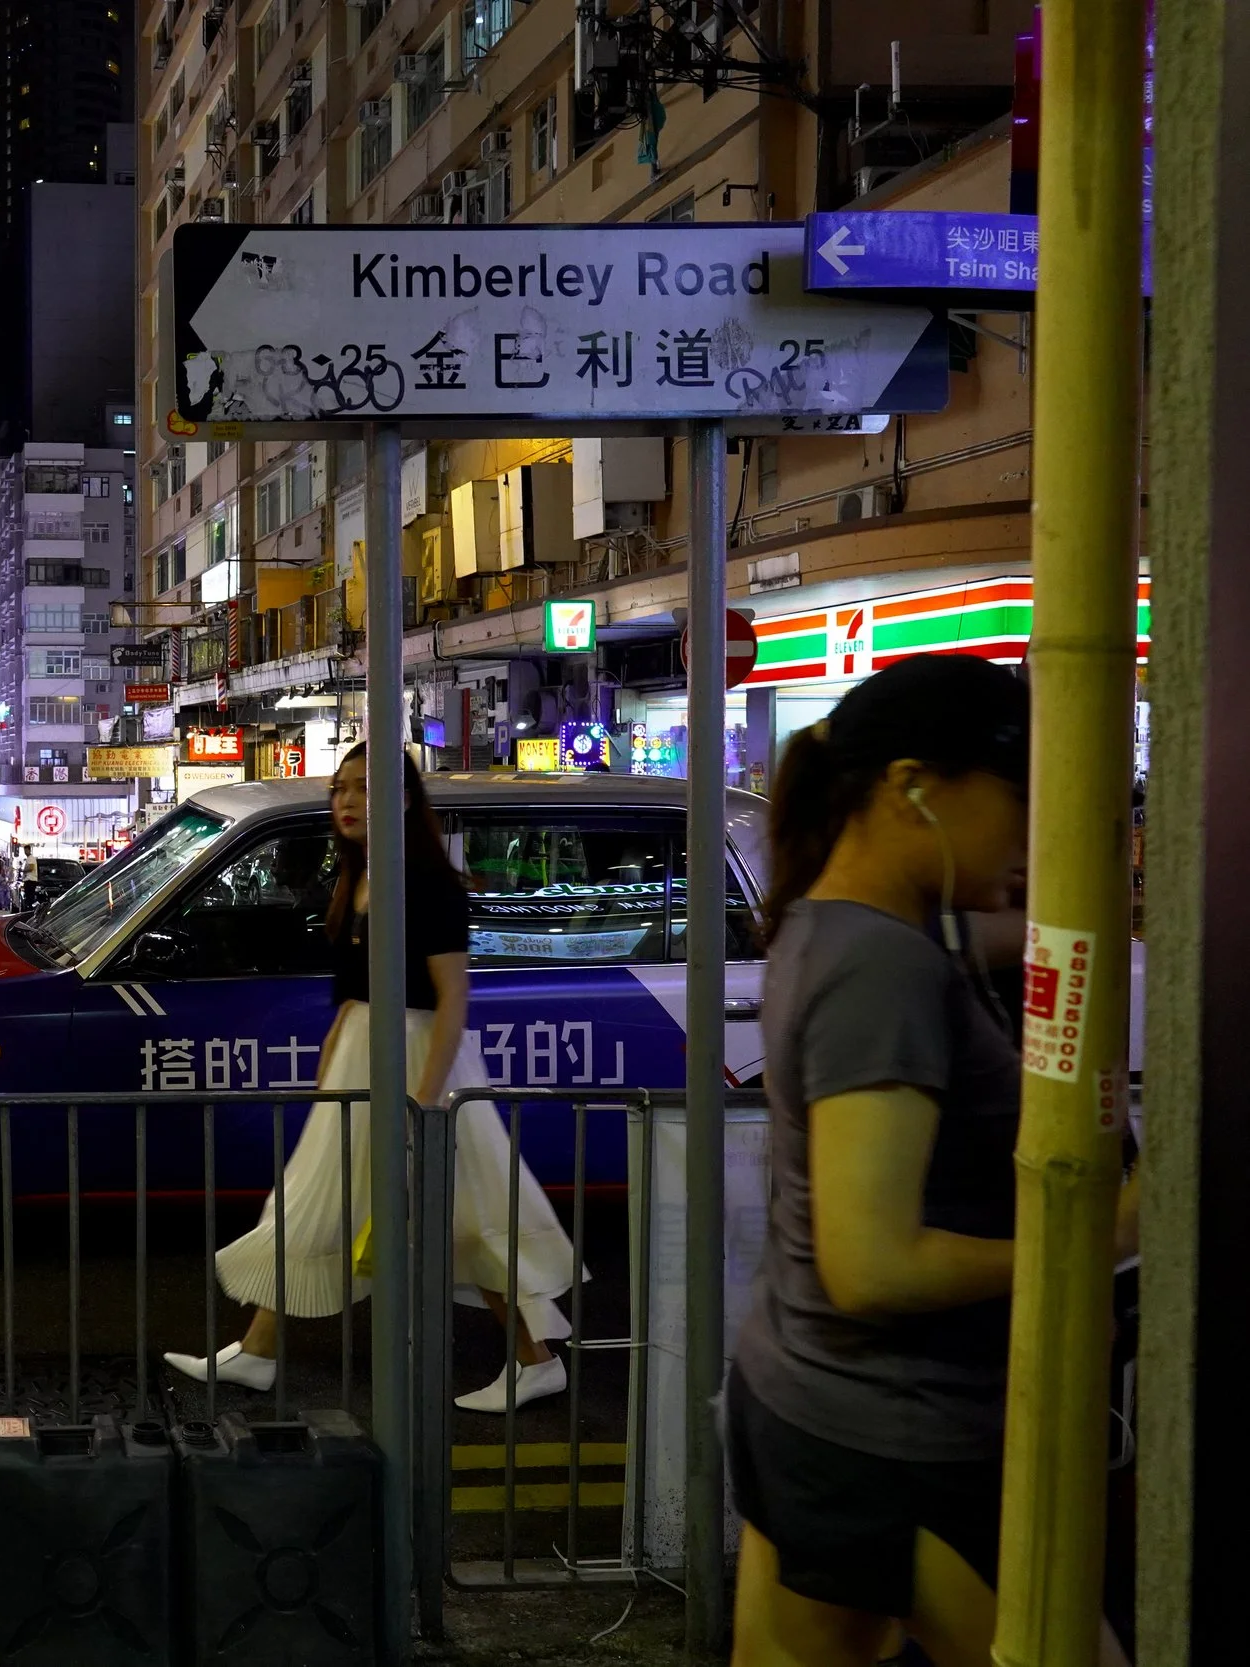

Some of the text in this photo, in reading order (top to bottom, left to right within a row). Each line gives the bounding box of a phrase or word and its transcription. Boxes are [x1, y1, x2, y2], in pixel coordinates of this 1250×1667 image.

[353, 251, 770, 306] Kimberley Road
[946, 258, 997, 280] Tsim
[519, 741, 549, 757] MONEY
[141, 1035, 321, 1091] 搭的士
